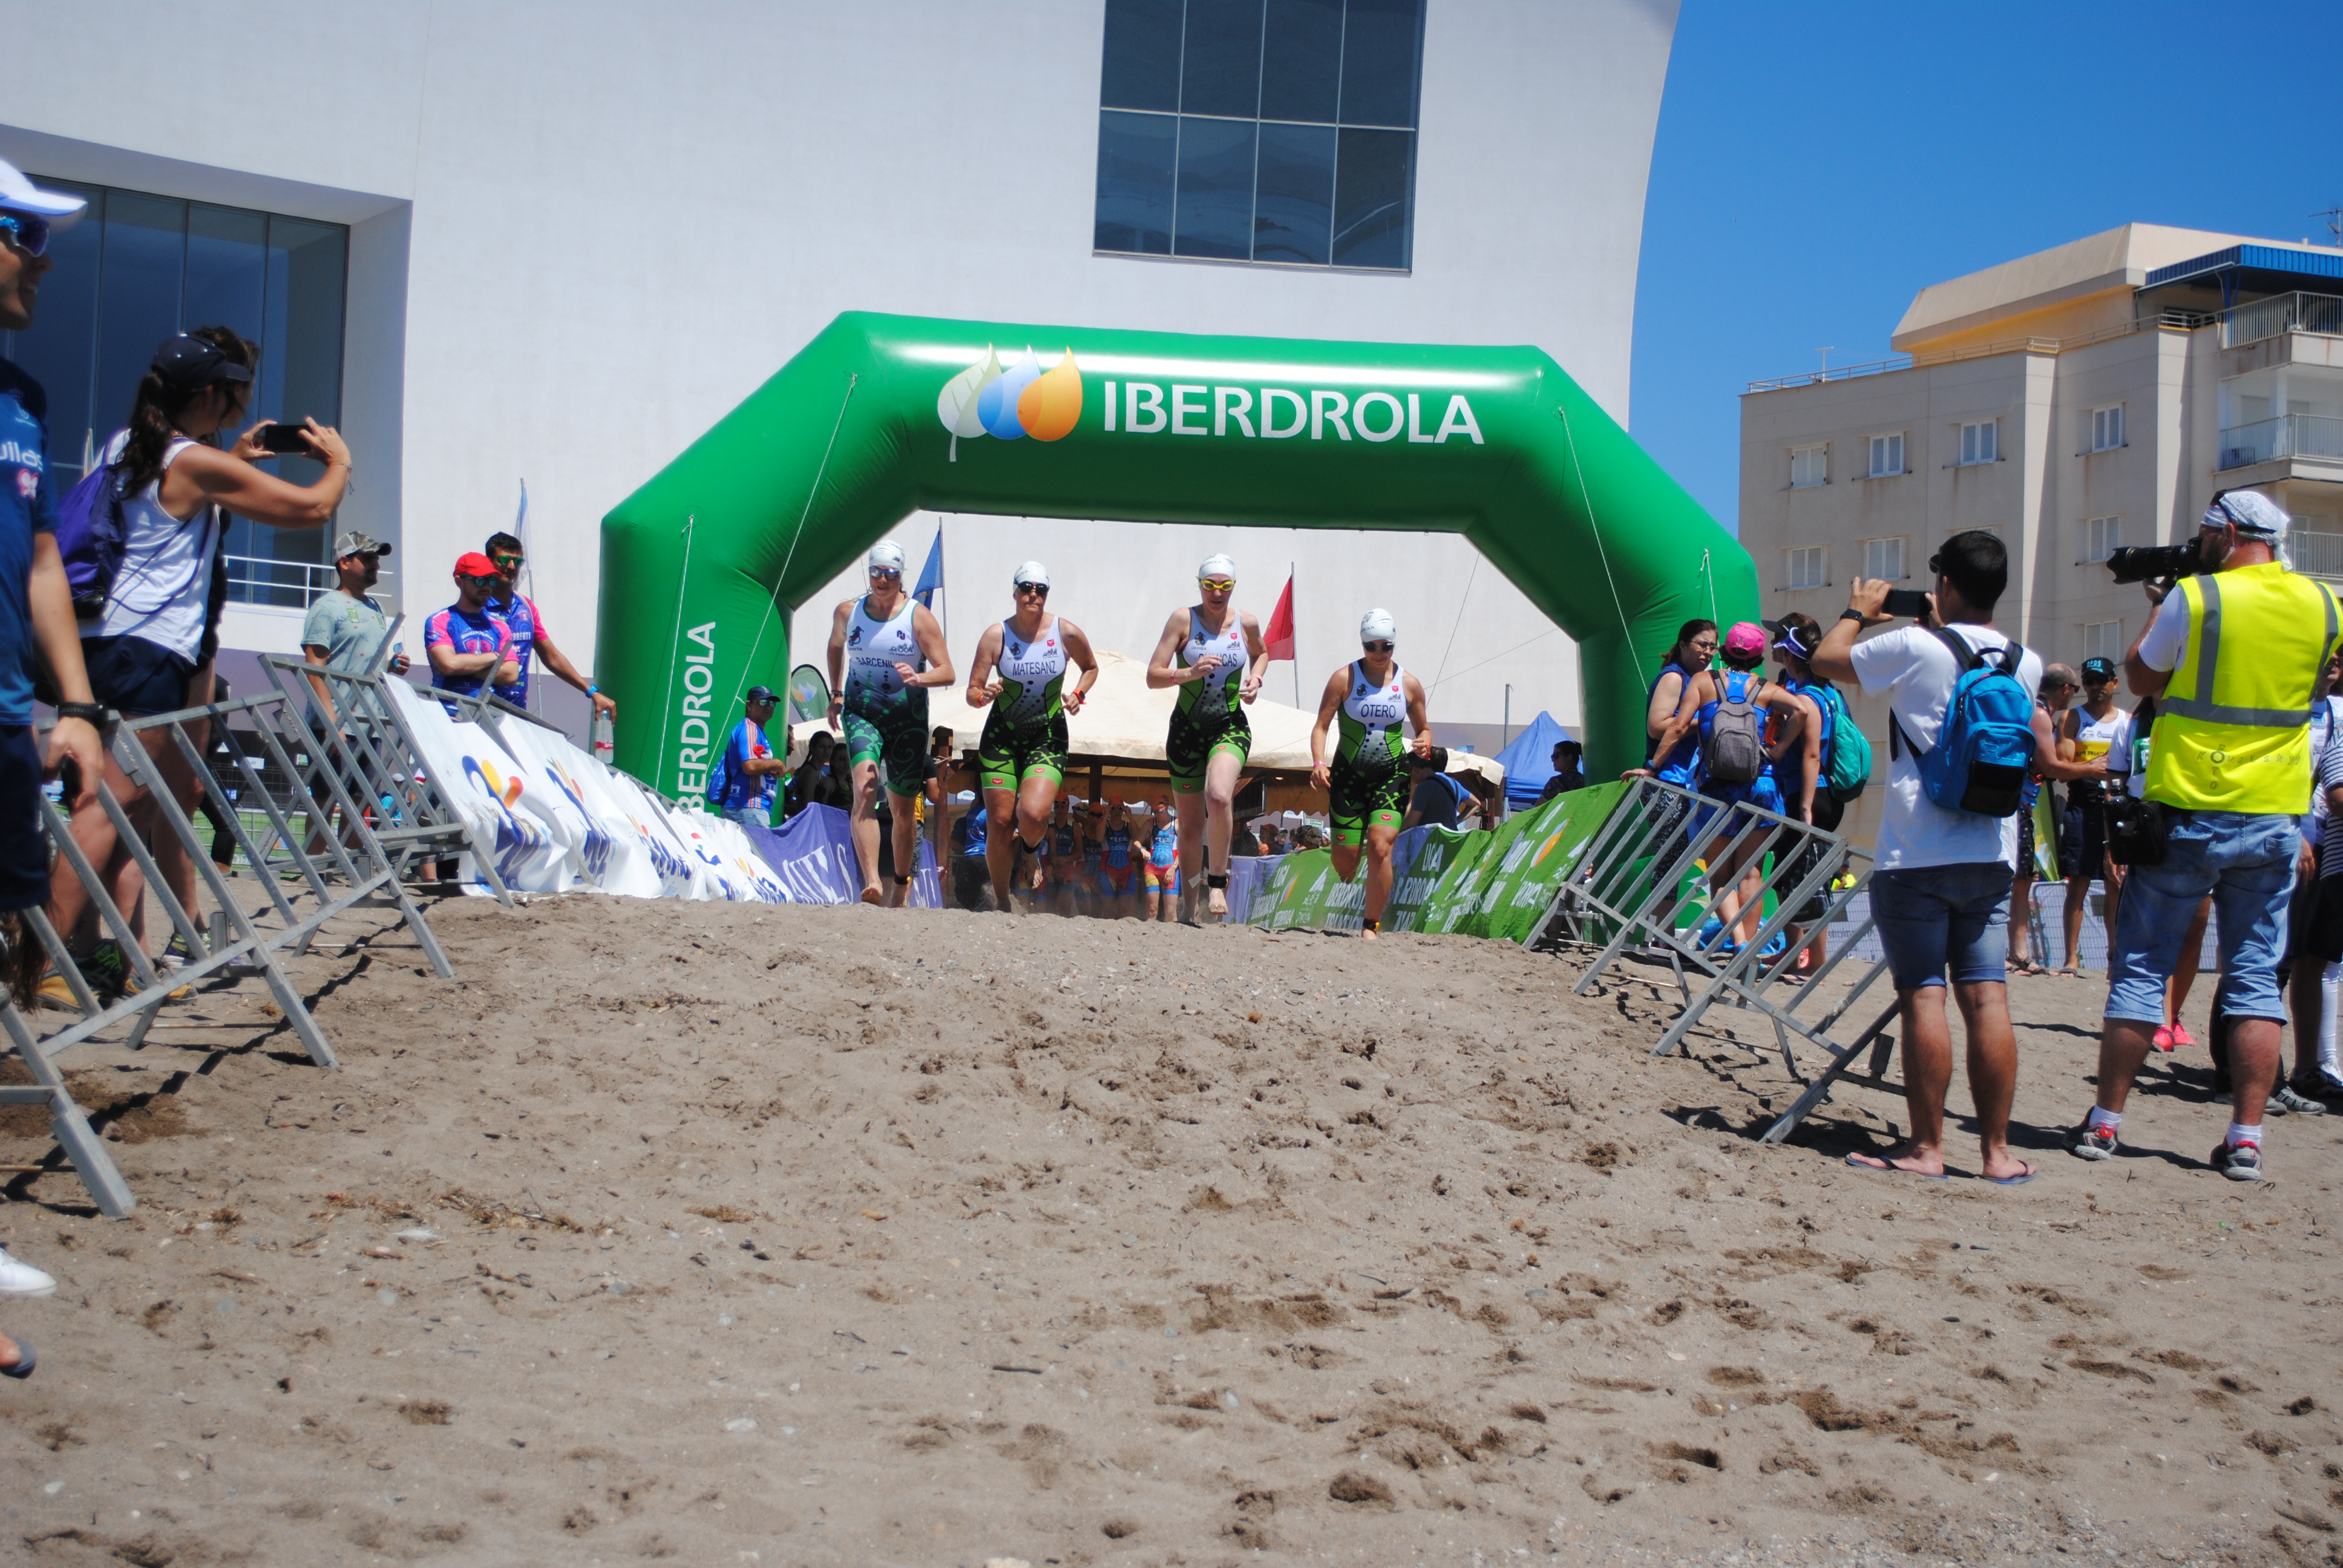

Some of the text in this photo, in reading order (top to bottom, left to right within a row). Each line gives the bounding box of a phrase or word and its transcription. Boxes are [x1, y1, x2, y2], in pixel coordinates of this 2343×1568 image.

[1105, 381, 1484, 445] IBERDROLA
[856, 657, 895, 668] BARCENIL
[1012, 661, 1057, 676] MATESANZ
[677, 621, 716, 813] BERDROLA
[1361, 704, 1396, 718] OTERO
[1324, 883, 1366, 910] IBERDROL
